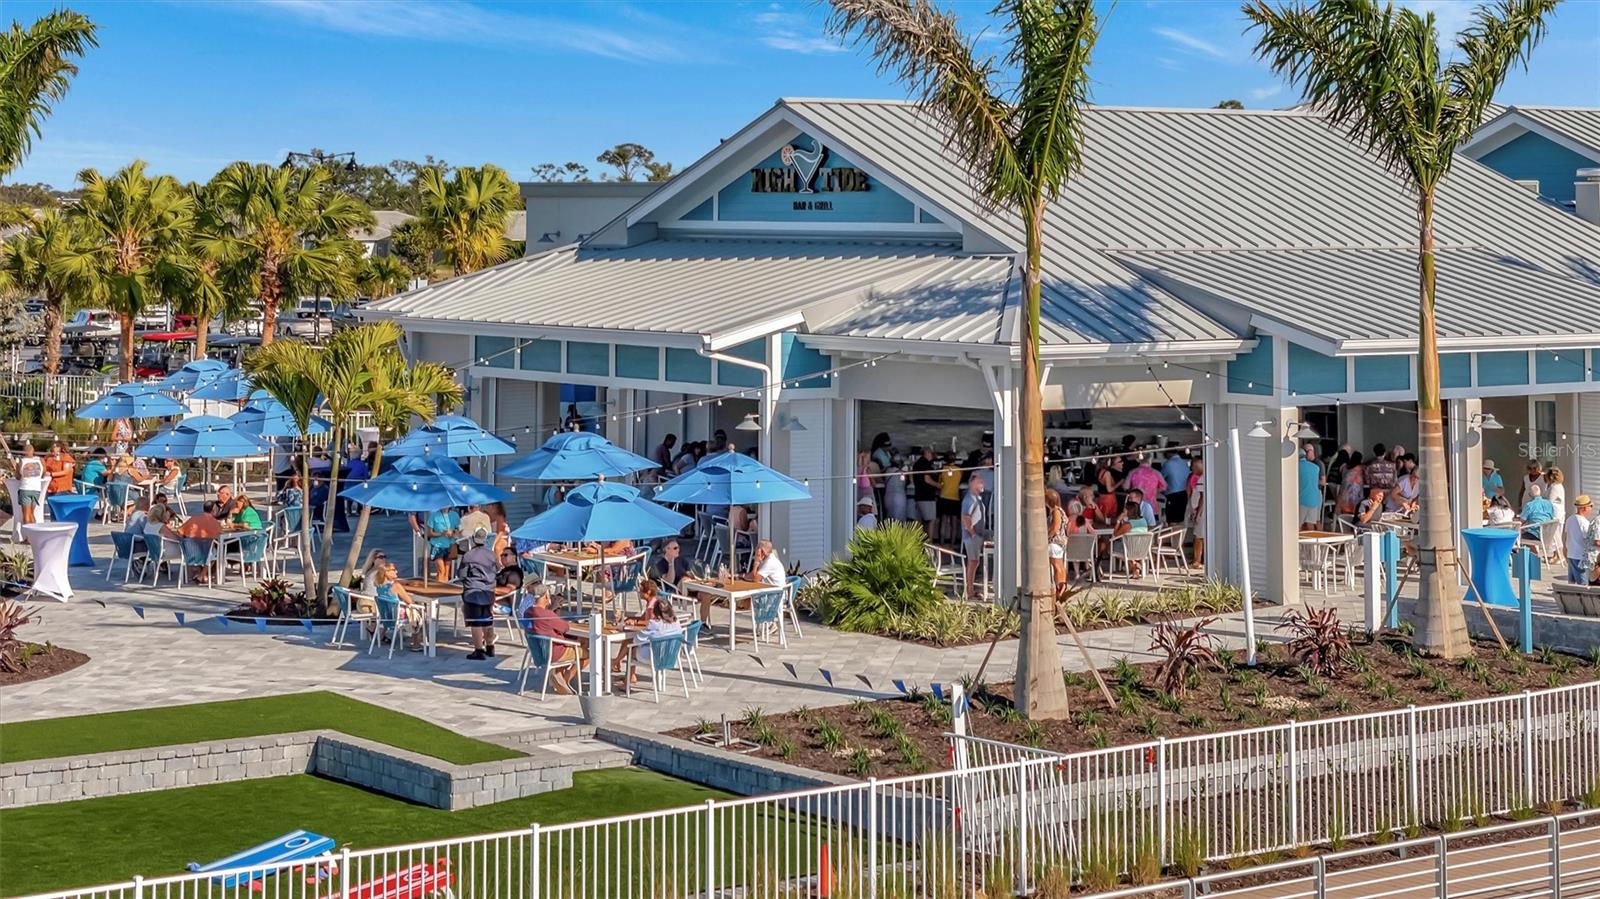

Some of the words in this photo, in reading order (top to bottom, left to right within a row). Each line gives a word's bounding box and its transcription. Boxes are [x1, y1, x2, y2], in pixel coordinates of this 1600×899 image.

[751, 167, 798, 192] HIGH
[819, 167, 869, 192] TIDE
[793, 201, 807, 210] BAR
[807, 201, 813, 210] &
[814, 201, 833, 210] GRILL
